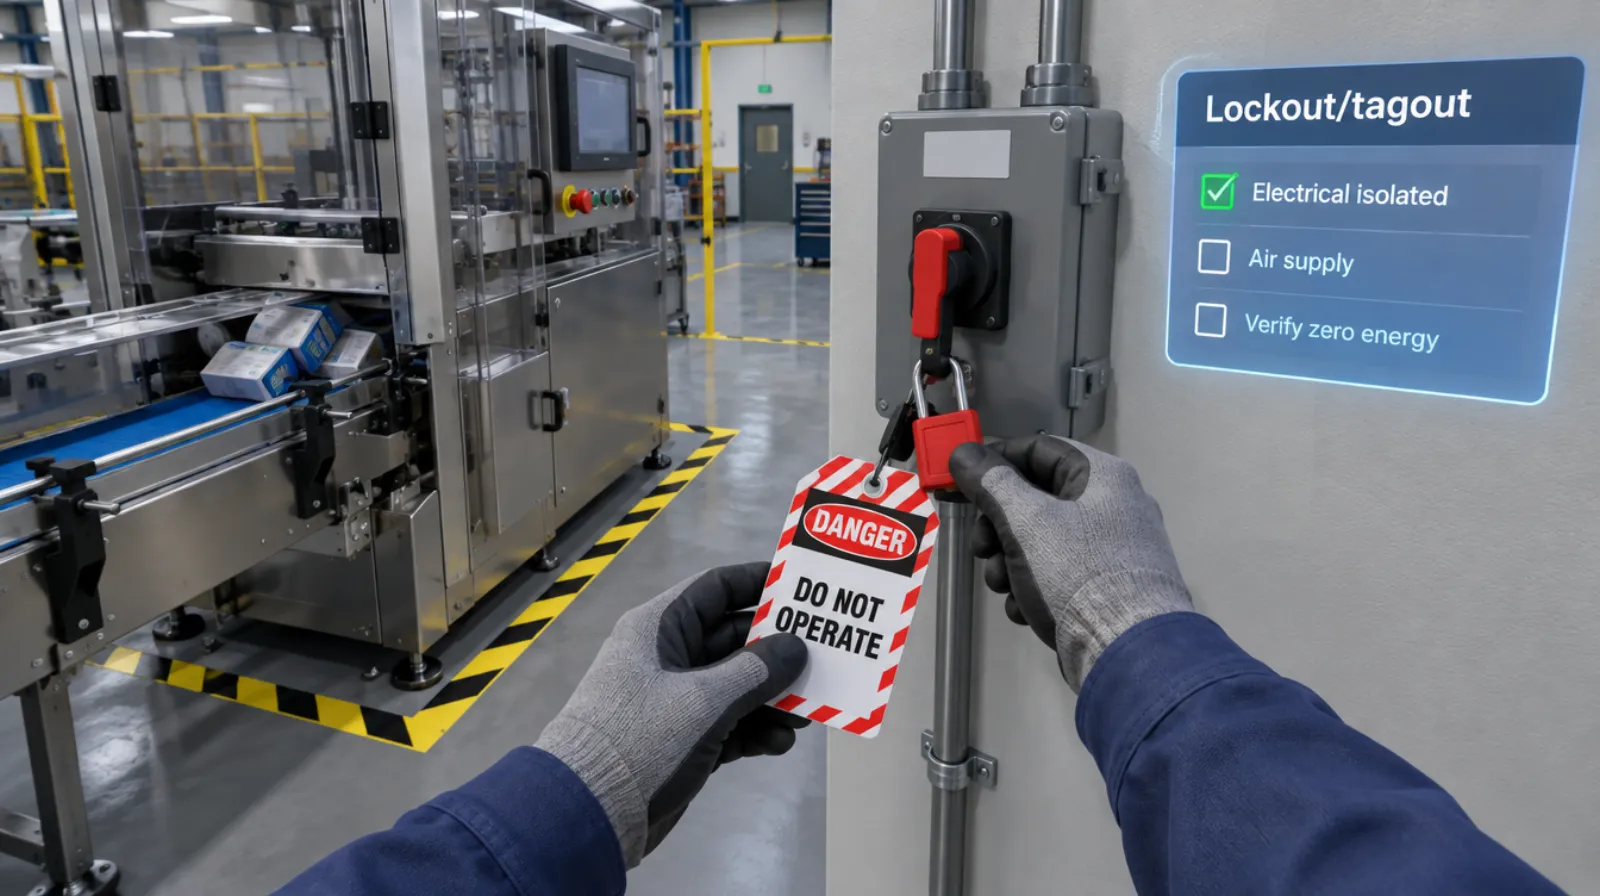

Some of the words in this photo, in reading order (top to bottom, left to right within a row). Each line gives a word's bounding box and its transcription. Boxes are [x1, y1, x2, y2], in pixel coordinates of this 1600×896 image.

[813, 509, 907, 555] DANGER
[793, 576, 828, 607] DO
[832, 588, 885, 623] NOT
[776, 606, 883, 659] OPERATE
